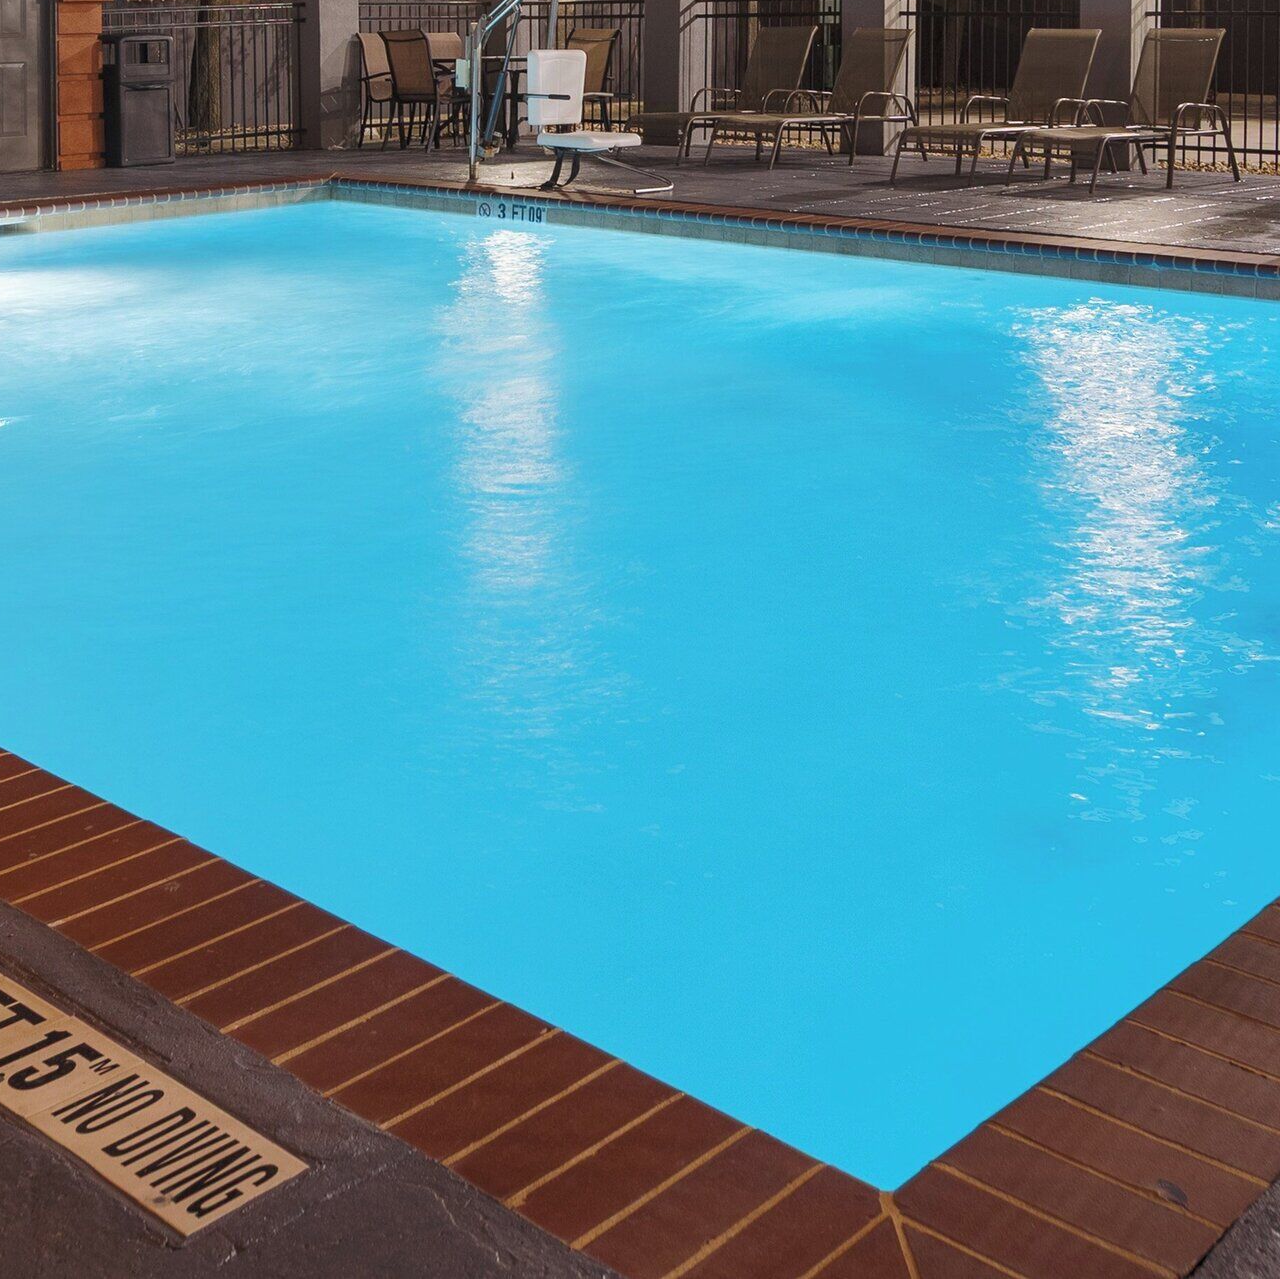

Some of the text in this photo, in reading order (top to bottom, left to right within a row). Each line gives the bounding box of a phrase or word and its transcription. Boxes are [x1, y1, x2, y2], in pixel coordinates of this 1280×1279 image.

[497, 203, 506, 219] 3
[511, 204, 527, 221] FT
[51, 1073, 164, 1134] NO
[101, 1106, 279, 1218] DIVING
